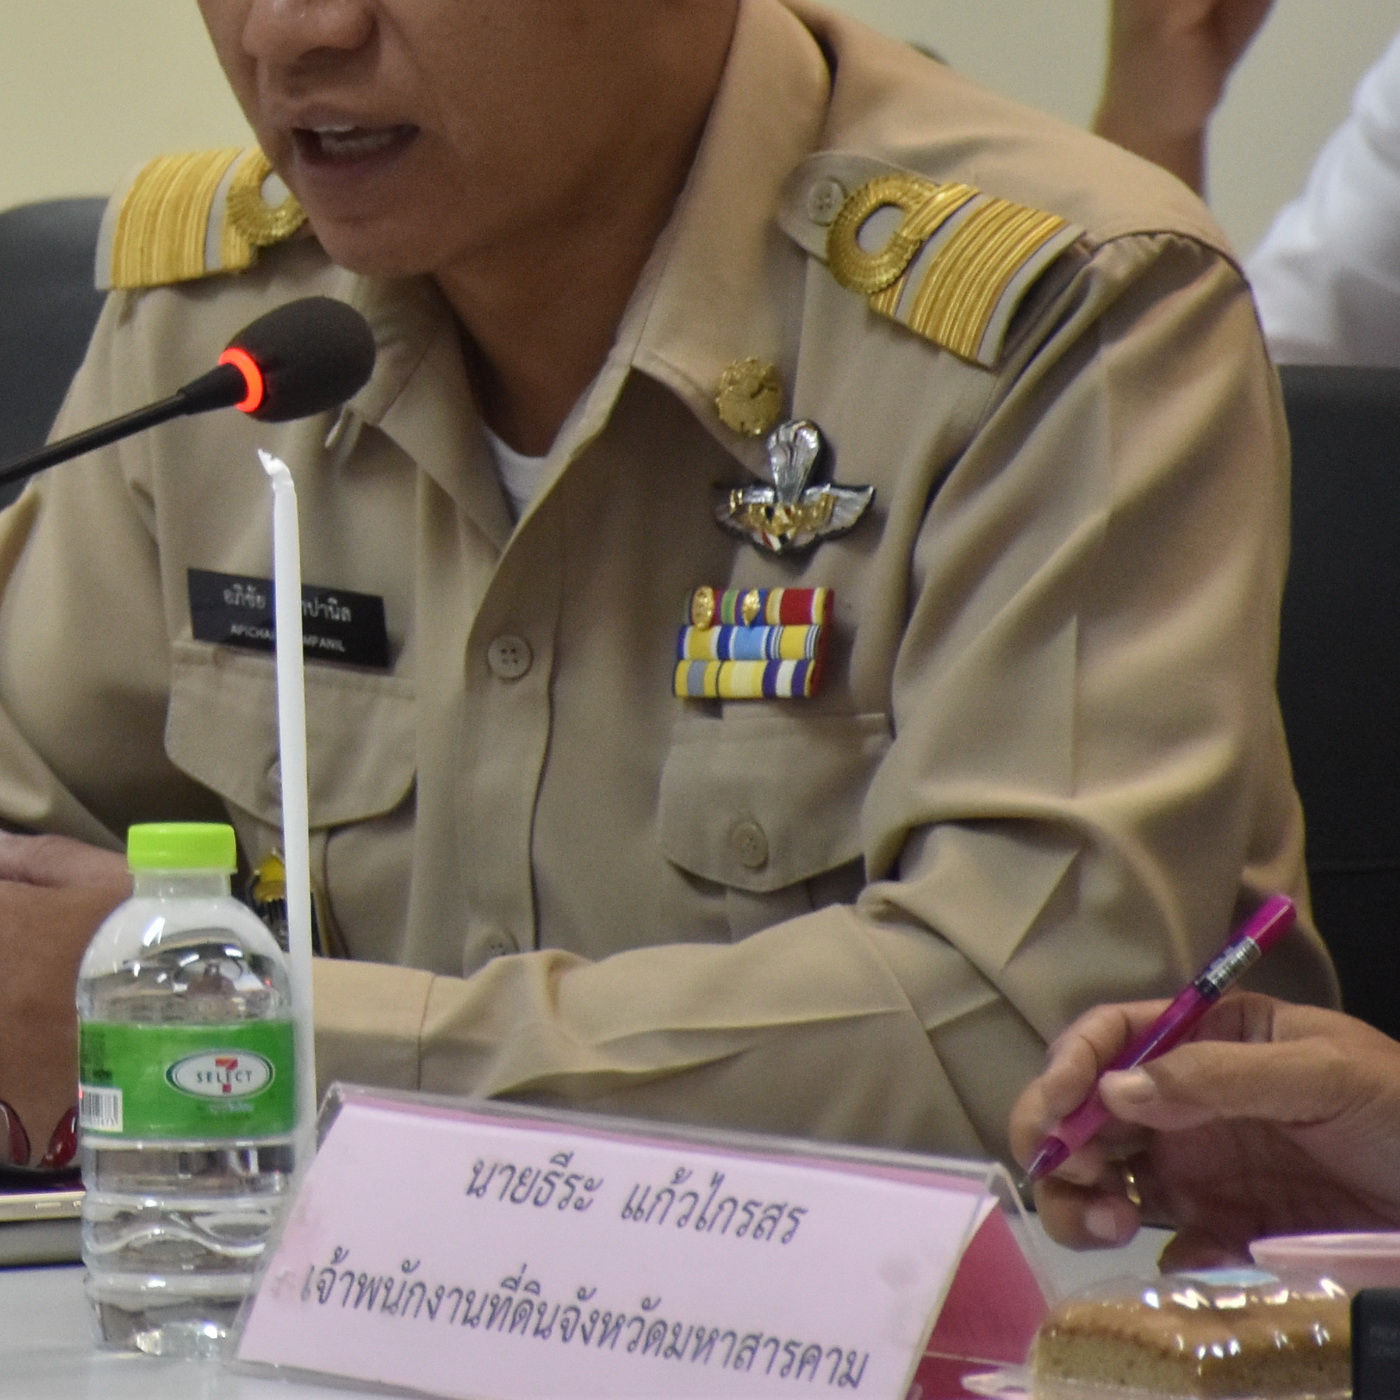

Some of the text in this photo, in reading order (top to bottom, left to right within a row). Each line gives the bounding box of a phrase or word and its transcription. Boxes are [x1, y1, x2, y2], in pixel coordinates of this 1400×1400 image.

[230, 623, 274, 641] APICHA
[196, 1070, 253, 1084] SELECT
[465, 1151, 809, 1245] นายธีระ แก้วไกรสร
[300, 1246, 870, 1391] เจ้าพนักงานที่ดินจังหวัดมหาสารคาม
